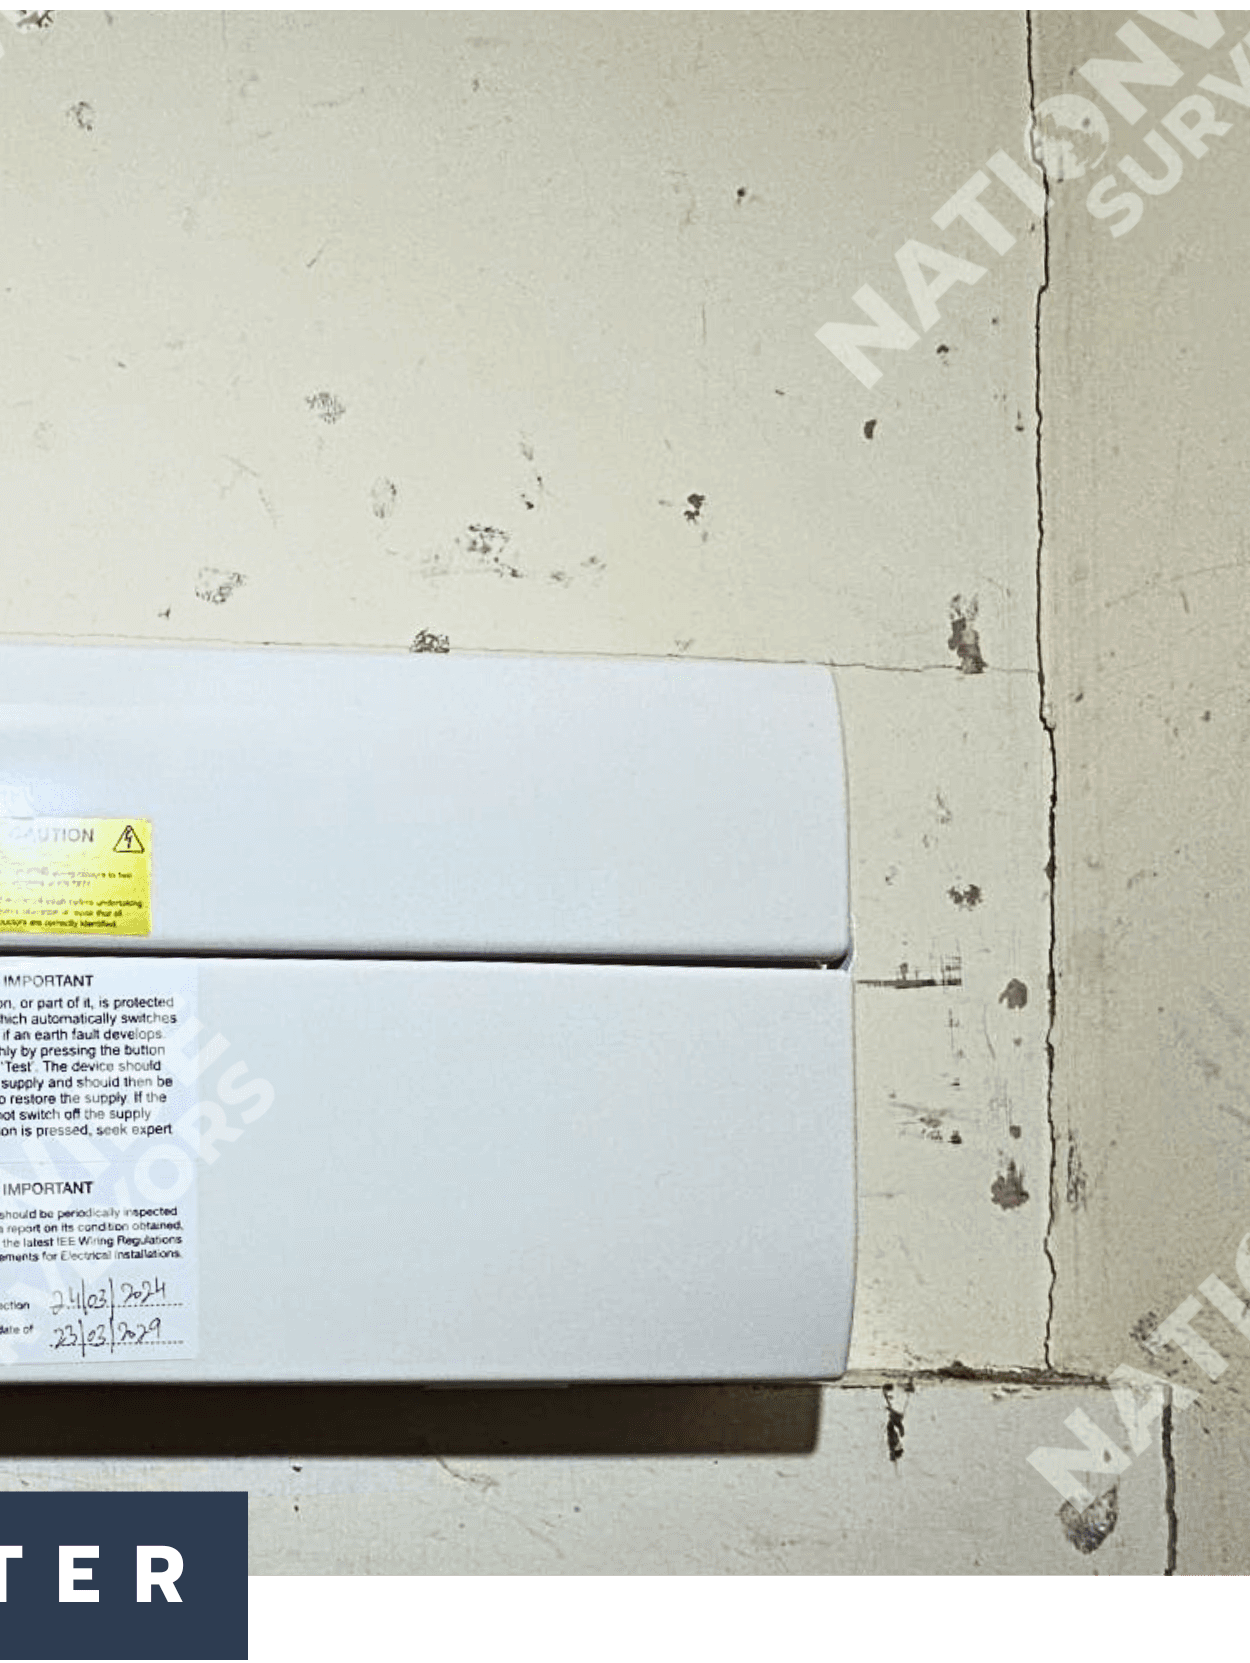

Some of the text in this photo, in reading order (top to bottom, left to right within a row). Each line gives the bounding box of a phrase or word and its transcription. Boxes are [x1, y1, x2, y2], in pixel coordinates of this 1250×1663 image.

[3, 974, 94, 988] IMPORTANT
[20, 999, 34, 1009] or
[37, 998, 63, 1011] part
[66, 996, 80, 1008] of
[99, 996, 110, 1009] is
[113, 997, 174, 1010] protected
[31, 1012, 117, 1029] automatically
[121, 1012, 178, 1024] switches
[3, 1029, 10, 1040] if
[13, 1031, 31, 1040] an
[35, 1029, 67, 1041] earth
[72, 1028, 99, 1040] fault
[20, 1045, 37, 1060] by
[41, 1045, 96, 1059] pressing
[100, 1044, 120, 1056] the
[124, 1044, 165, 1056] button
[42, 1058, 68, 1072] The
[71, 1060, 114, 1072] device
[119, 1060, 161, 1072] should
[1, 1077, 44, 1091] supply
[48, 1076, 73, 1088] and
[77, 1076, 119, 1088] should
[124, 1076, 152, 1087] then
[157, 1075, 173, 1087] be
[10, 1094, 56, 1105] restore
[60, 1093, 80, 1104] the
[134, 1091, 143, 1103] If
[146, 1092, 167, 1103] the
[19, 1108, 60, 1120] switch
[64, 1108, 81, 1120] off
[85, 1108, 105, 1120] the
[110, 1107, 151, 1122] supply
[21, 1125, 32, 1137] is
[36, 1124, 92, 1138] pressed,
[96, 1123, 127, 1136] seek
[132, 1123, 173, 1138] expert
[3, 1181, 94, 1196] IMPORTANT
[0, 1209, 37, 1220] should
[39, 1210, 54, 1219] be
[57, 1208, 120, 1221] periodically
[124, 1206, 177, 1218] inspected
[7, 1224, 41, 1235] report
[43, 1224, 58, 1233] on
[61, 1223, 74, 1232] its
[2, 1239, 20, 1247] the
[23, 1238, 54, 1247] latest
[57, 1237, 76, 1246] IEE
[117, 1235, 183, 1247] Regulations
[42, 1251, 58, 1261] for
[61, 1251, 111, 1261] Electrical
[23, 1324, 34, 1334] of
